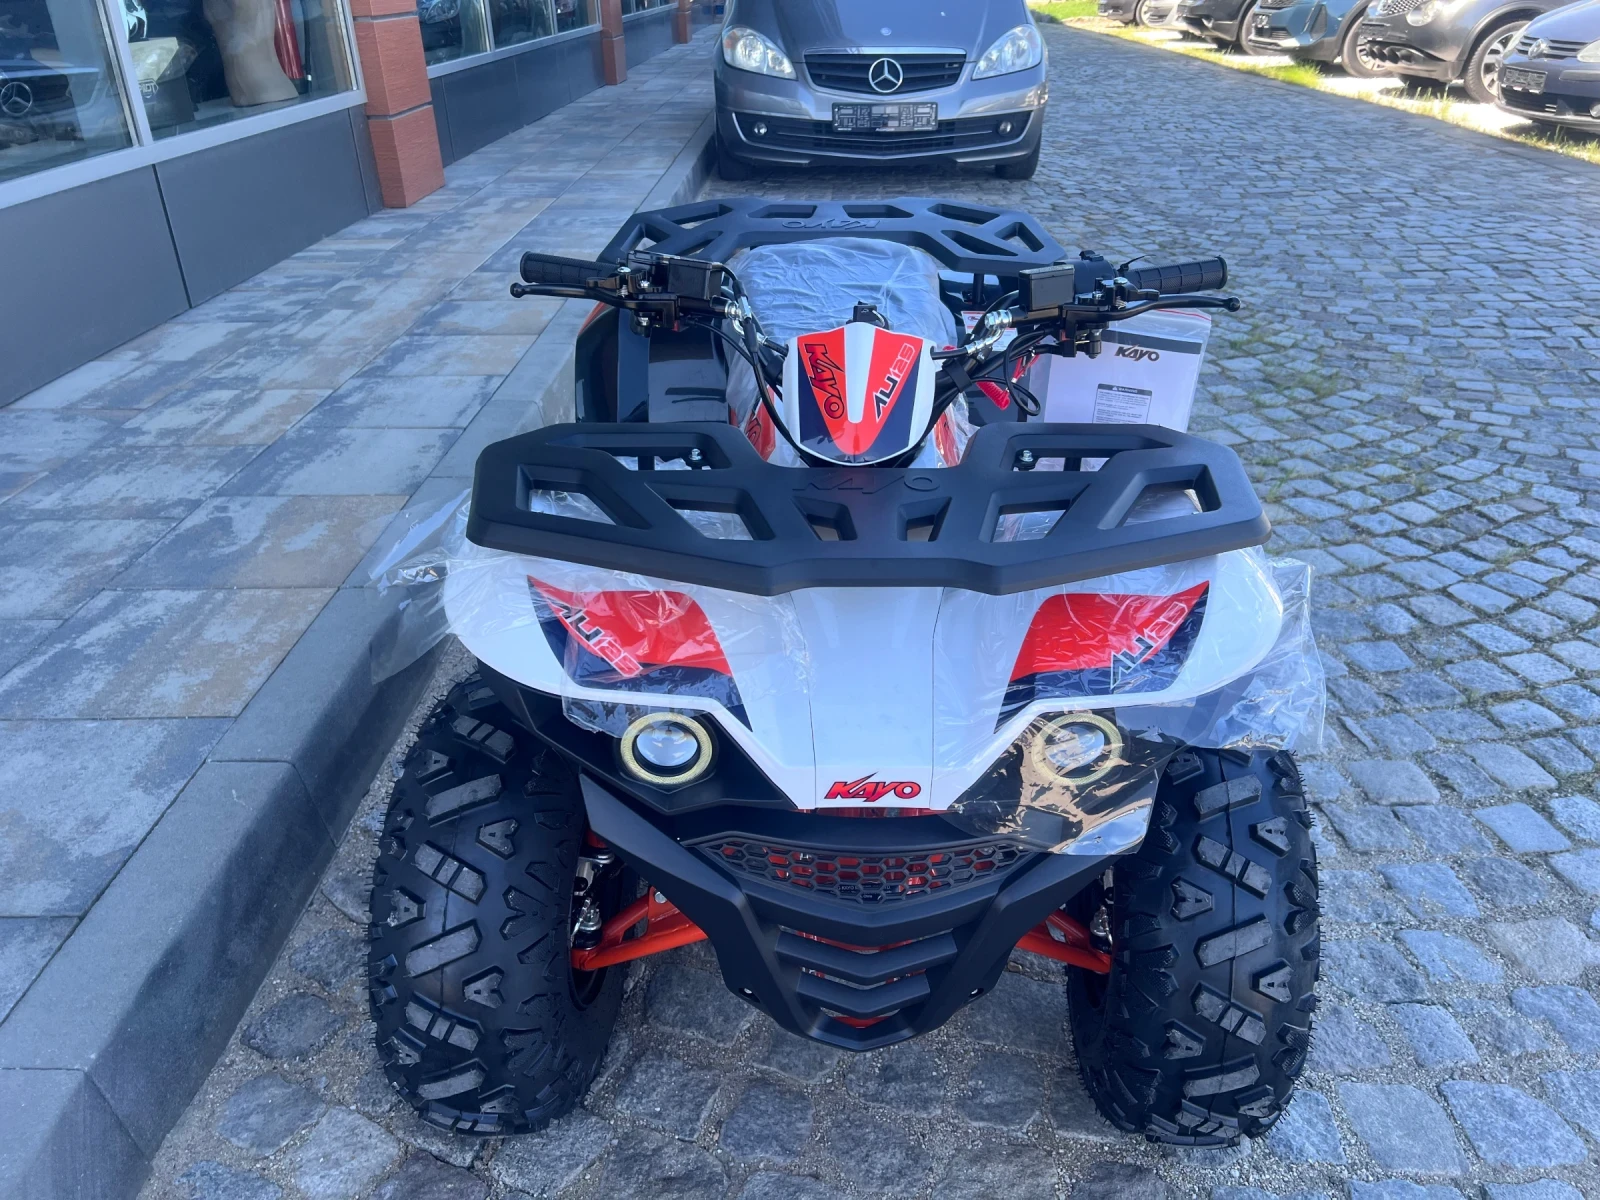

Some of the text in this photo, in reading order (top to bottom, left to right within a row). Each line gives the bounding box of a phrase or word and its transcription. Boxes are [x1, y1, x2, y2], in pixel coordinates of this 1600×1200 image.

[804, 343, 845, 420] KAYO
[872, 342, 916, 424] AU125
[1114, 344, 1160, 362] KAYO
[546, 598, 644, 678] AU125
[1109, 601, 1189, 690] AU125
[823, 771, 922, 803] KAYO
